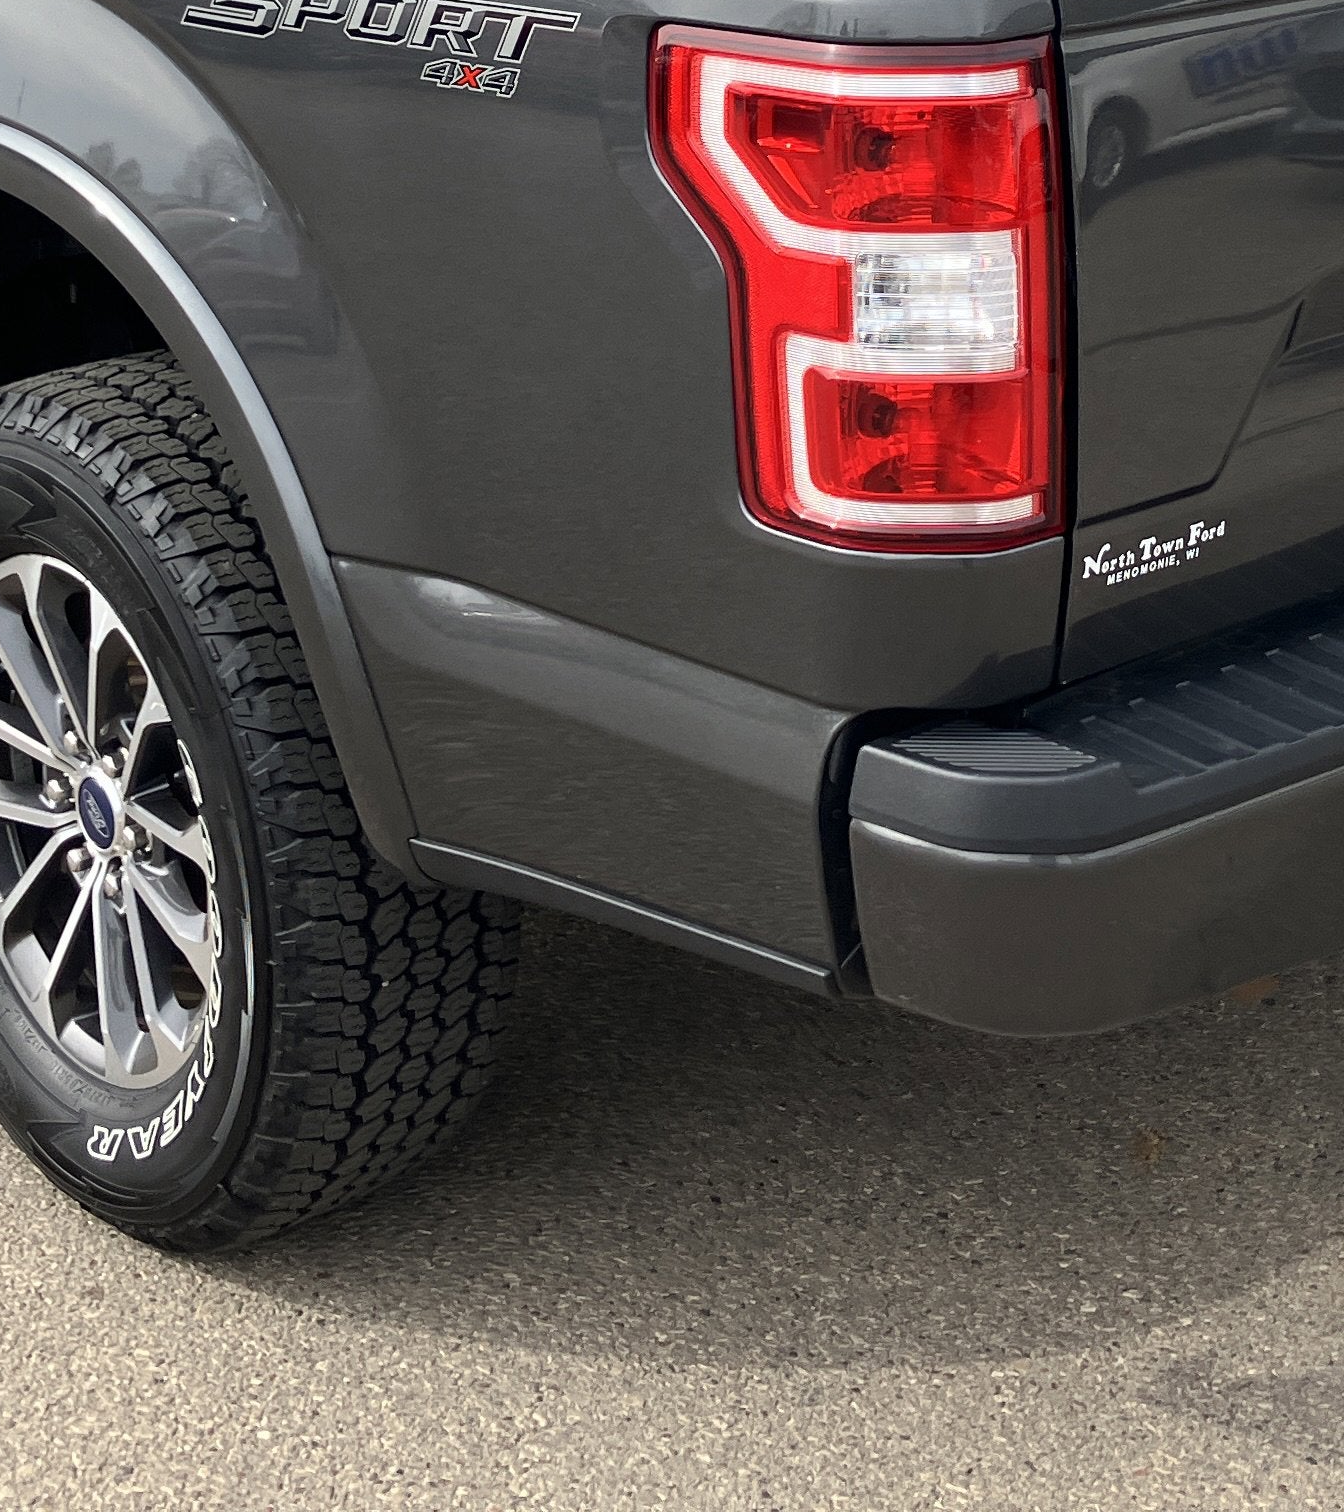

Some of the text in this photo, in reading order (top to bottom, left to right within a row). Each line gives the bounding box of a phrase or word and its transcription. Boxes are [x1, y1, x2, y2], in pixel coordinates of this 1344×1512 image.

[1082, 520, 1226, 579] North Town Ford
[1106, 548, 1200, 586] MENOMONIE, WI
